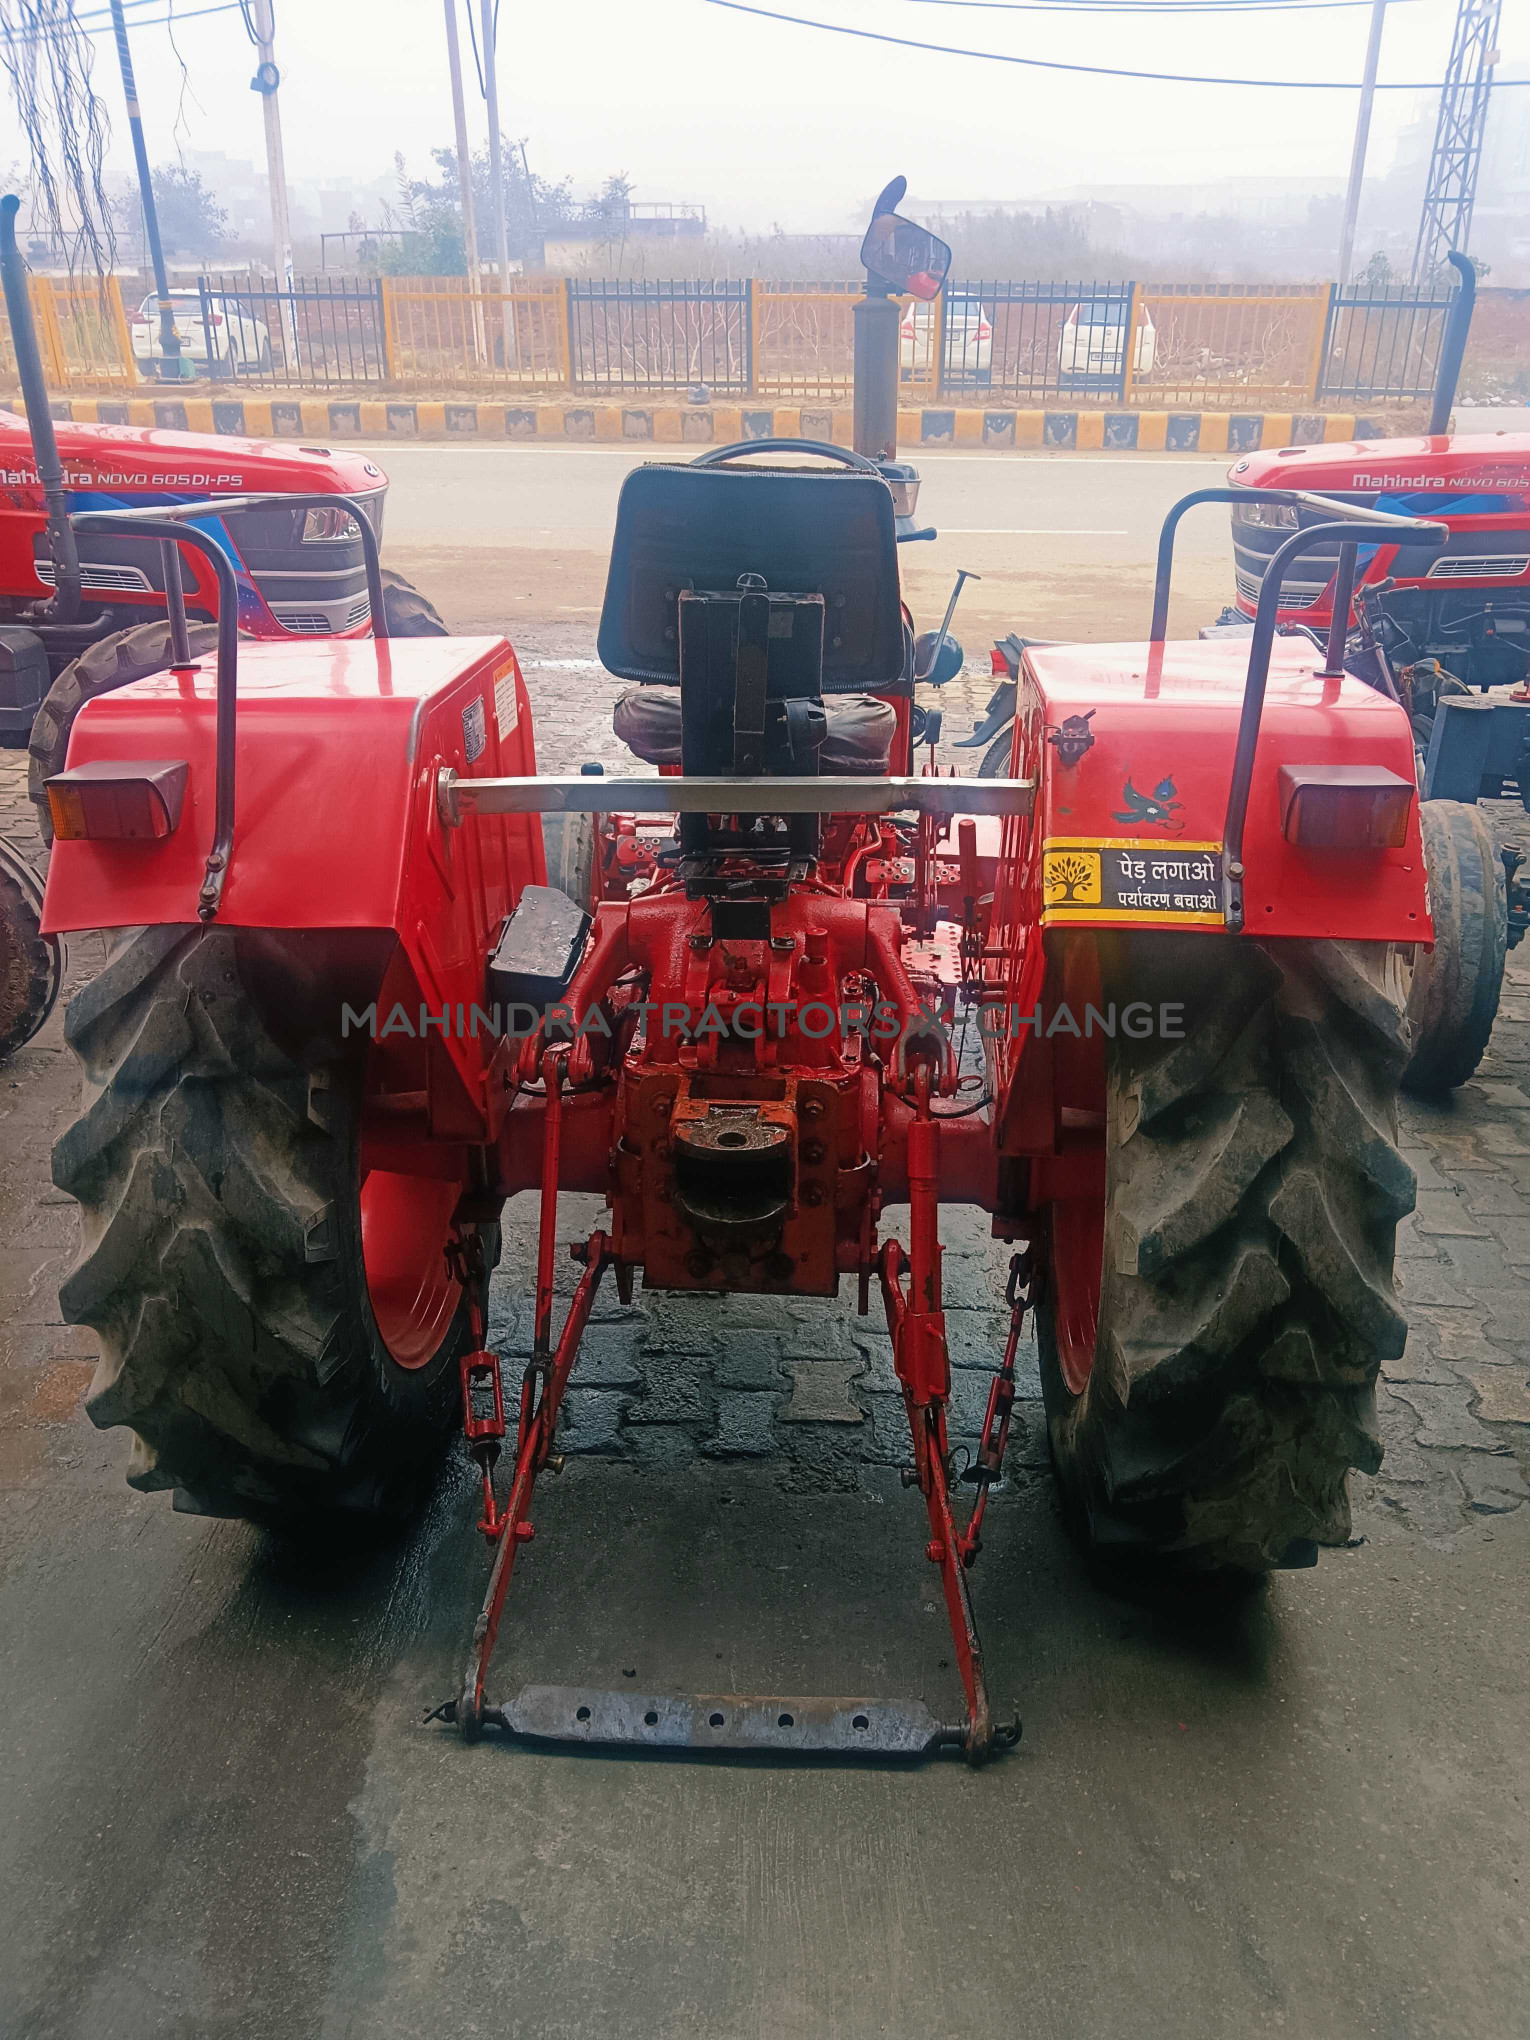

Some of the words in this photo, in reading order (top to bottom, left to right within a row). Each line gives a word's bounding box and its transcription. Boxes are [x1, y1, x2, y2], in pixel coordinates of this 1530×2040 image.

[97, 473, 147, 485] NOVO
[1352, 474, 1445, 487] Mahindra
[1449, 477, 1493, 488] NOVO
[1496, 478, 1530, 488] 605
[1119, 852, 1147, 884] पेड़
[1151, 854, 1216, 881] लगाओ
[1117, 886, 1171, 908] पर्यावरण
[1173, 888, 1217, 910] बचाओ
